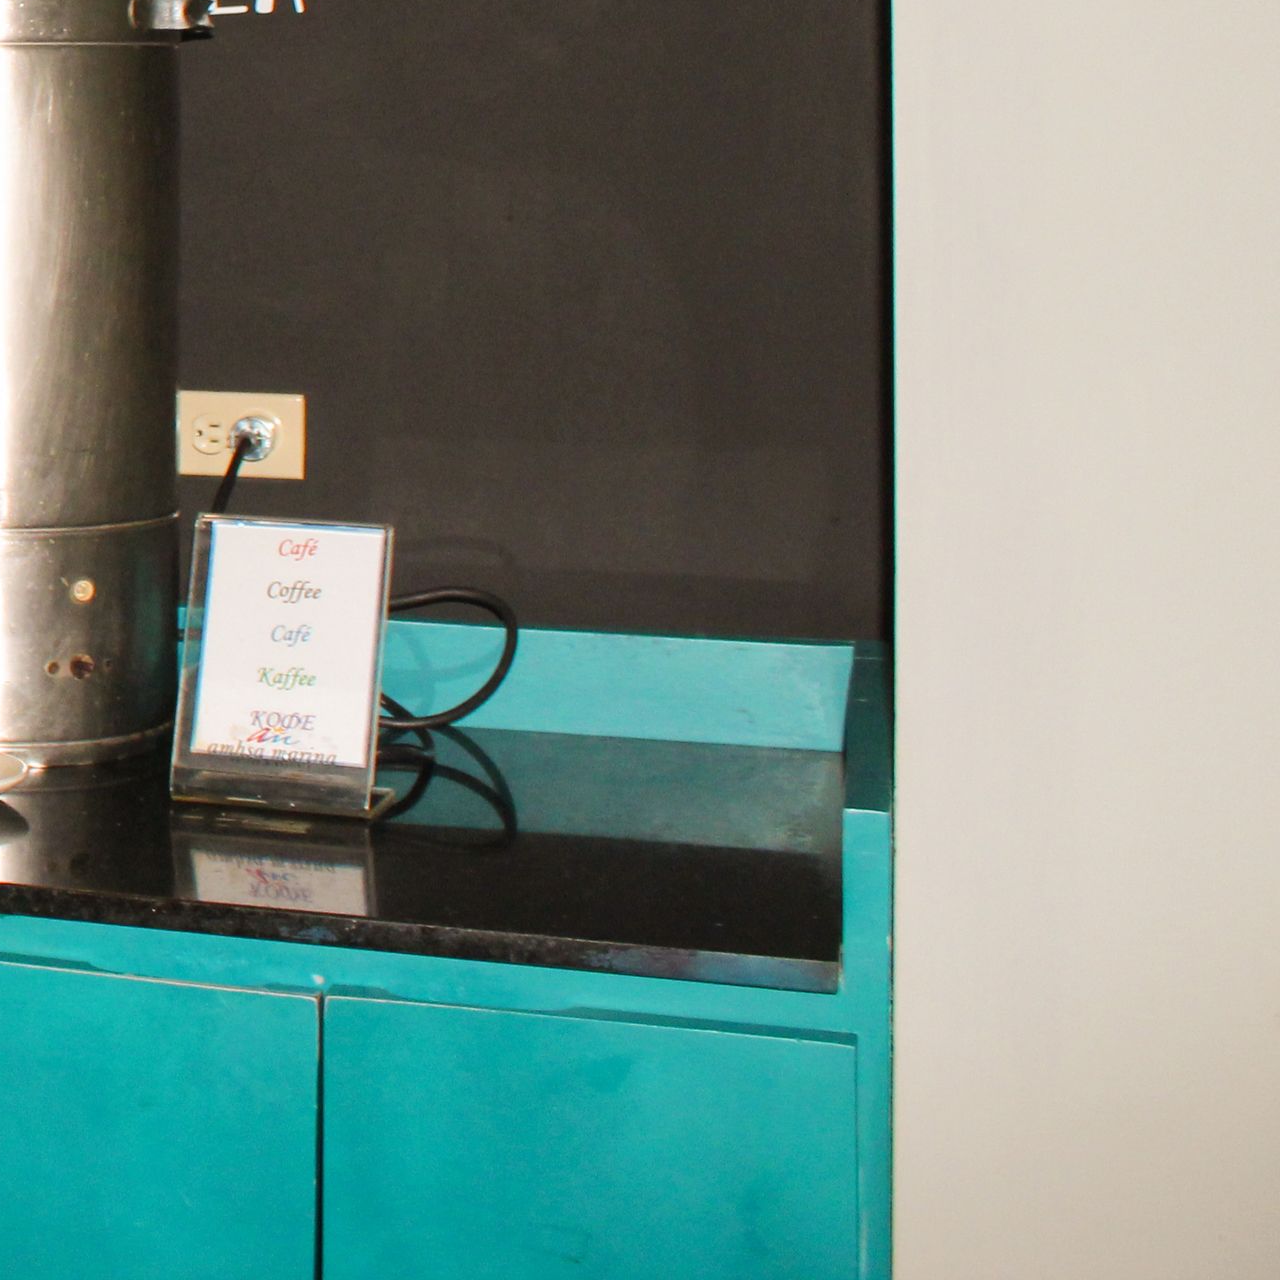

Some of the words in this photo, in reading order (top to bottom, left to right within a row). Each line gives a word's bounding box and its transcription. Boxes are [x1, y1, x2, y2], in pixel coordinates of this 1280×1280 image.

[278, 537, 319, 562] Café
[266, 579, 323, 605] Coffee
[270, 623, 313, 648] Café
[256, 665, 318, 692] Kaffee
